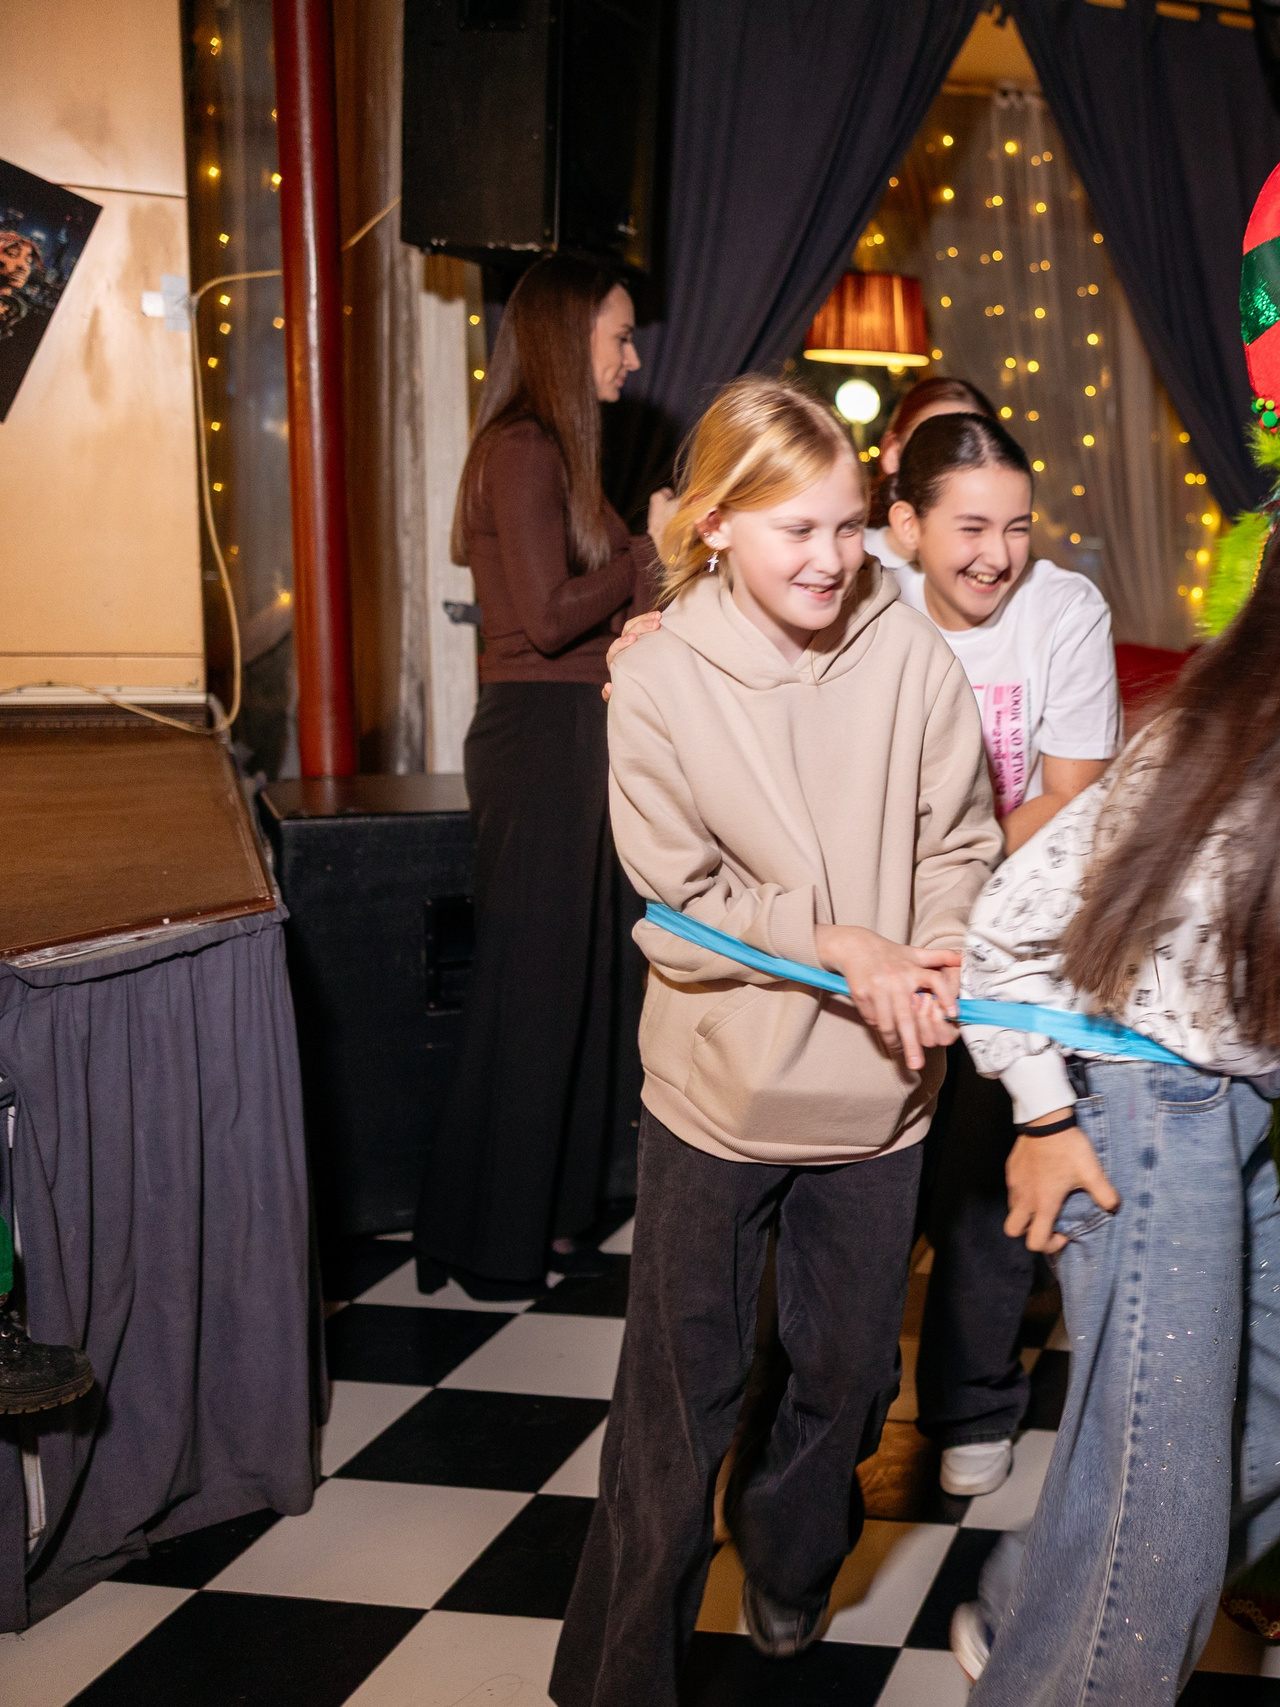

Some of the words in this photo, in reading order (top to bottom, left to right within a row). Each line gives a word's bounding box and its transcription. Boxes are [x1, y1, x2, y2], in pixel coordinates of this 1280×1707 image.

[1010, 685, 1022, 721] MOON
[1010, 728, 1023, 746] ON
[1012, 751, 1023, 786] WALK
